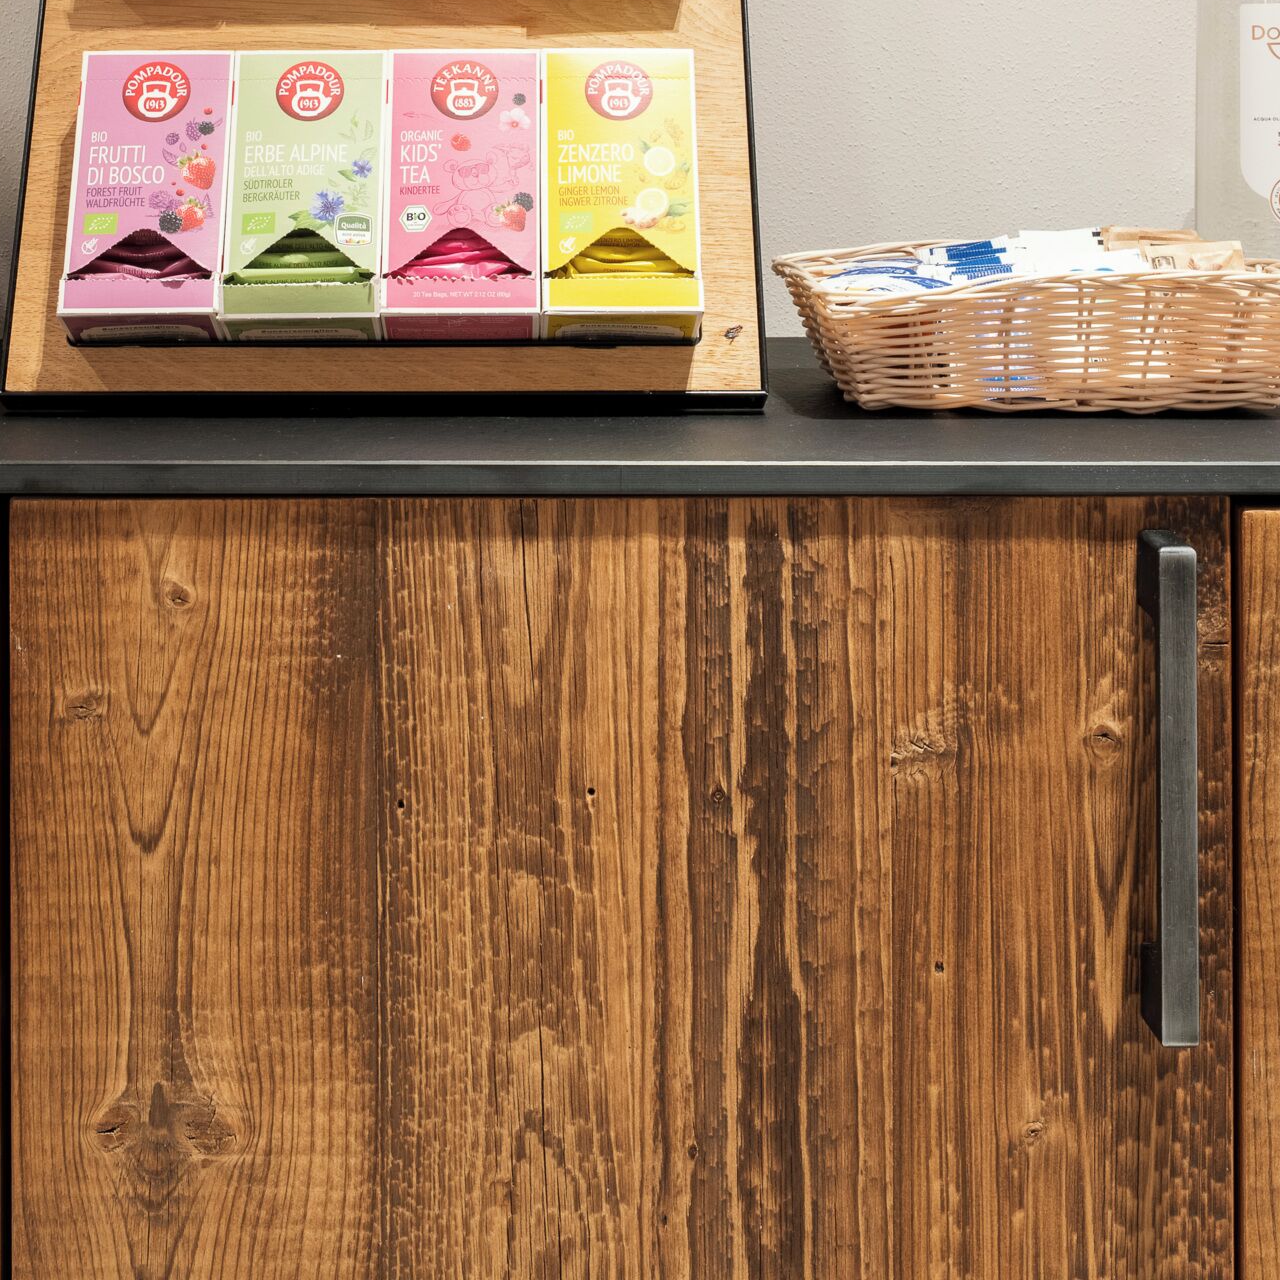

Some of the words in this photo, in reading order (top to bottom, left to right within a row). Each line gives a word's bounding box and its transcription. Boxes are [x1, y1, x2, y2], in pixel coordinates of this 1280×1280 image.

[125, 65, 188, 97] POMPADOUR
[279, 65, 341, 96] POMPADOUR
[434, 63, 496, 93] TEEKANNE
[587, 64, 650, 96] POMPADOUR
[146, 99, 165, 109] 1913
[300, 100, 319, 109] 1913
[609, 100, 629, 109] 1913
[91, 131, 107, 143] BIO
[246, 130, 263, 142] BIO
[400, 130, 444, 142] ORGANIC
[557, 129, 575, 141] BIO
[89, 145, 147, 164] FRUTTI
[244, 145, 286, 164] ERBE
[289, 144, 349, 163] ALPINE
[400, 144, 442, 163] KIDS'
[558, 144, 635, 163] ZENZERO
[87, 167, 103, 186] DI
[109, 166, 165, 185] BOSCO
[243, 164, 294, 177] DELL'ALTO
[296, 164, 326, 176] ADIGE
[400, 166, 431, 184] TEA
[558, 165, 622, 184] LIMONE
[243, 177, 294, 190] SÜDTIROLER
[86, 187, 116, 198] FOREST
[118, 186, 143, 197] FRUIT
[242, 190, 301, 203] BERGKRÄUTER
[399, 185, 441, 196] KINDERTEE
[558, 185, 589, 196] GINGER
[591, 185, 620, 195] LEMON
[85, 196, 146, 208] WALDFRÜCHTE
[559, 196, 593, 207] INGWER
[594, 195, 629, 206] ZITRONE
